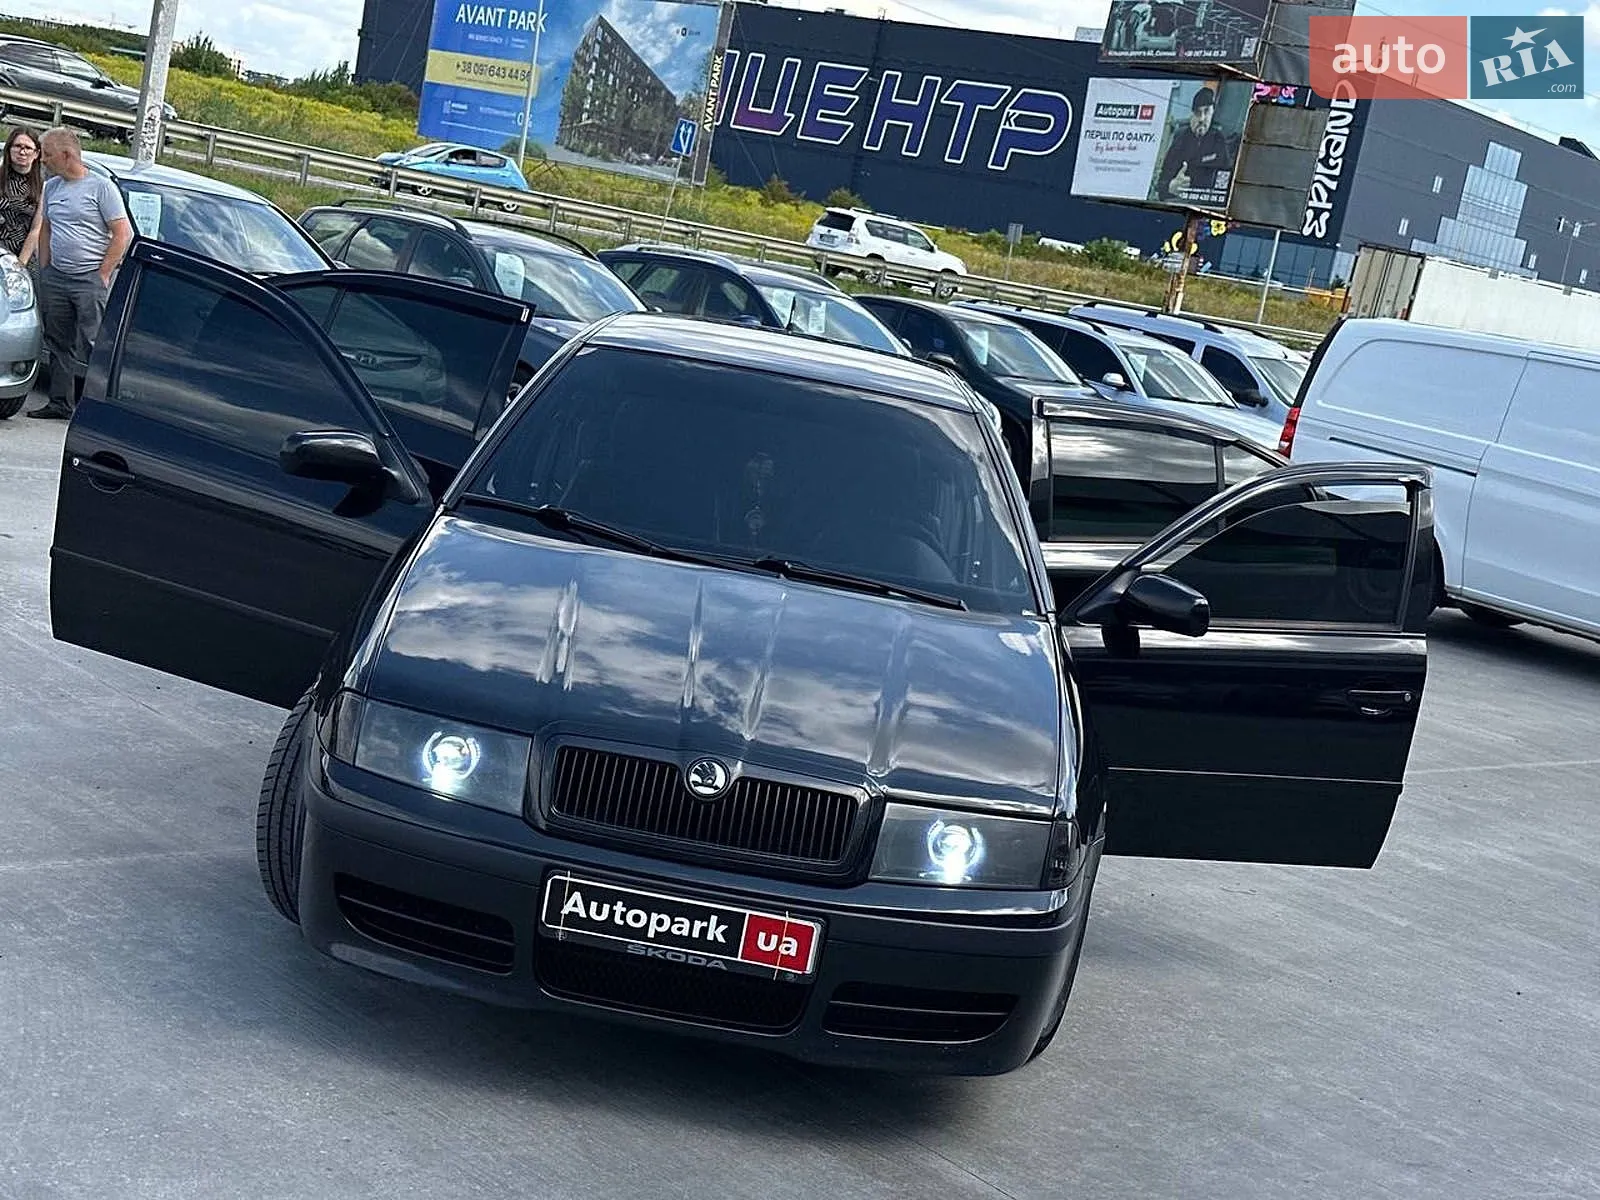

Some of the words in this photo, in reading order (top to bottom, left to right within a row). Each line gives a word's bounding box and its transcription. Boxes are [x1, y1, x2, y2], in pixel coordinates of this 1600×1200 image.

[455, 3, 506, 28] AVANT
[507, 10, 548, 32] PARK
[710, 55, 723, 88] PARK
[703, 88, 718, 132] AVANT
[1097, 105, 1137, 118] Autopark
[1111, 130, 1125, 141] ПО
[560, 891, 728, 943] Autopark
[756, 930, 799, 957] ua
